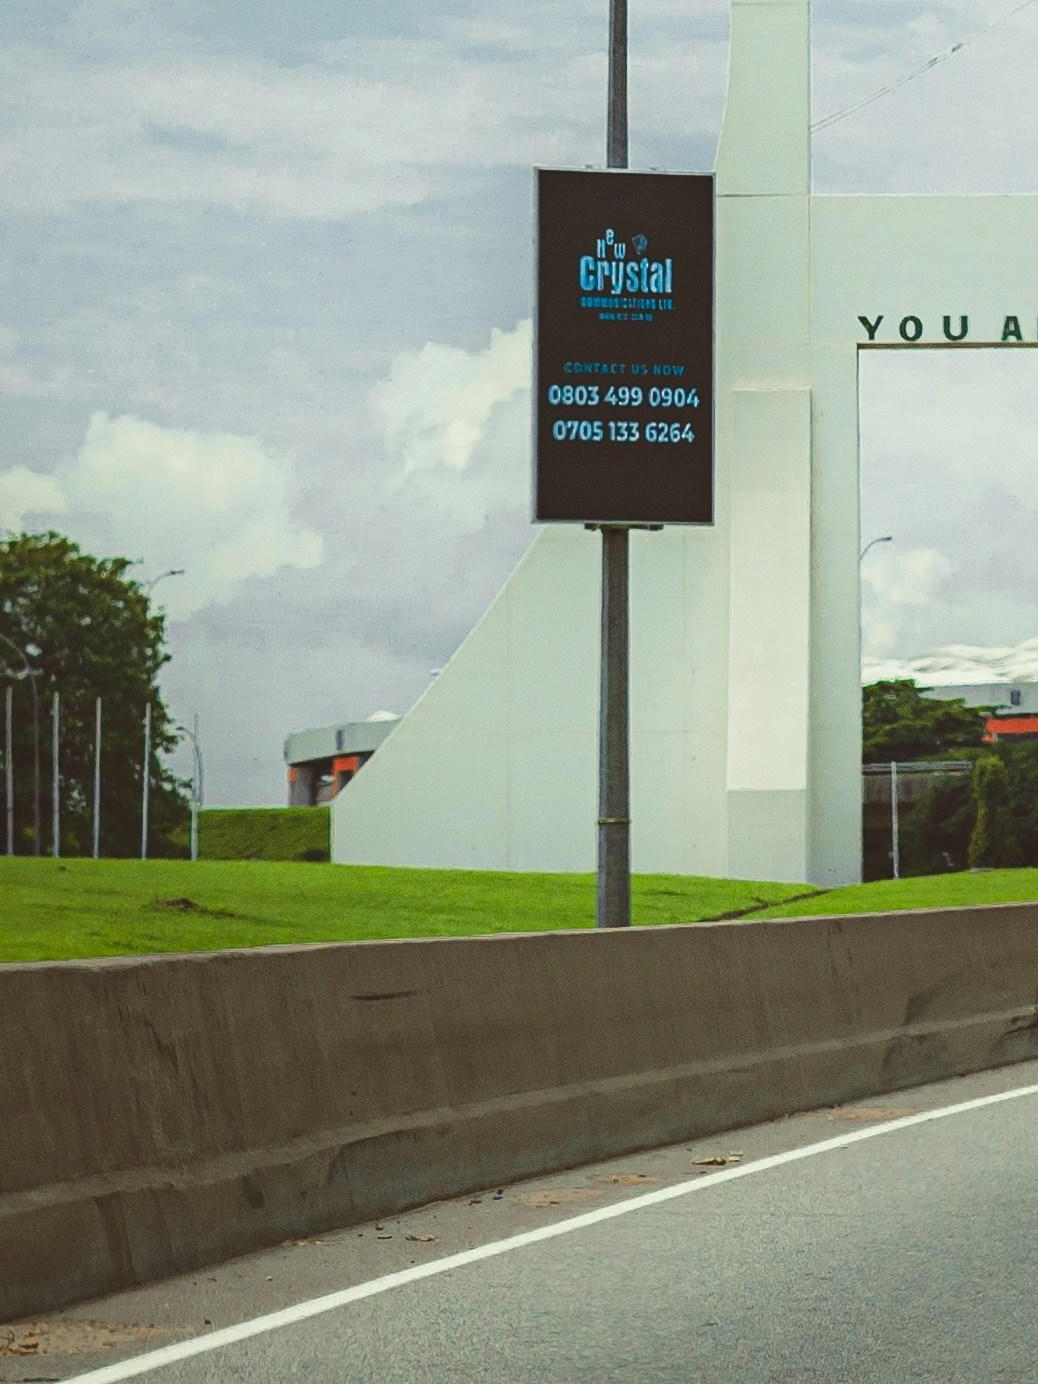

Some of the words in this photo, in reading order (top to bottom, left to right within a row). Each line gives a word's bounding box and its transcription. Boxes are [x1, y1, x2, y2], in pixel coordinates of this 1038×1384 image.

[580, 256, 673, 295] Crystal
[858, 315, 969, 341] YOU
[563, 361, 626, 375] CONTACT
[631, 362, 649, 375] US
[653, 363, 686, 377] NOW
[548, 384, 600, 407] 0803
[603, 385, 643, 407] 499
[648, 387, 700, 408] 0904
[553, 420, 603, 441] 0705
[608, 420, 640, 442] 133
[645, 422, 695, 443] 6264
